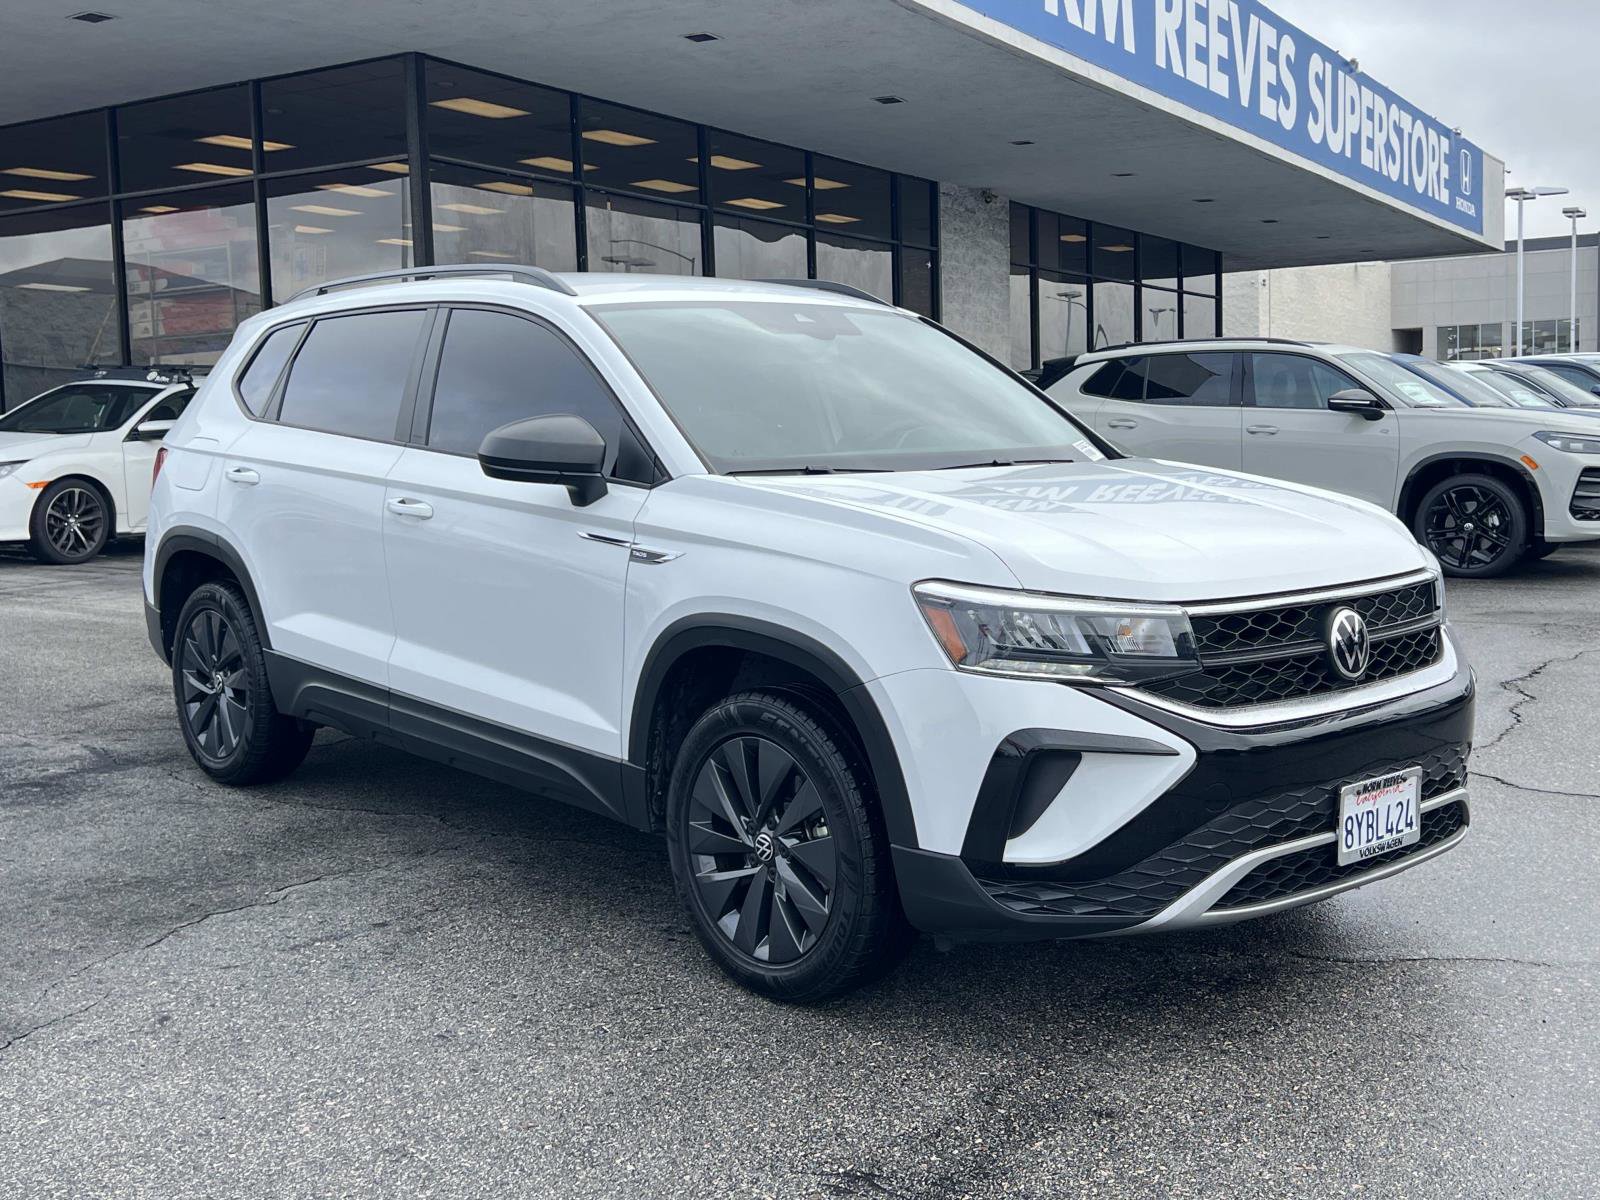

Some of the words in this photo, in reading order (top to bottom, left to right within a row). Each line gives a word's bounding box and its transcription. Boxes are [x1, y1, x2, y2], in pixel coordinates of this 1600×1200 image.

[1155, 0, 1297, 130] REEVES
[1307, 53, 1449, 205] SUPERSTORE
[1455, 196, 1476, 217] HONDA
[1345, 798, 1414, 850] 8YBL424
[1360, 836, 1405, 858] VOLKSWAGEN
